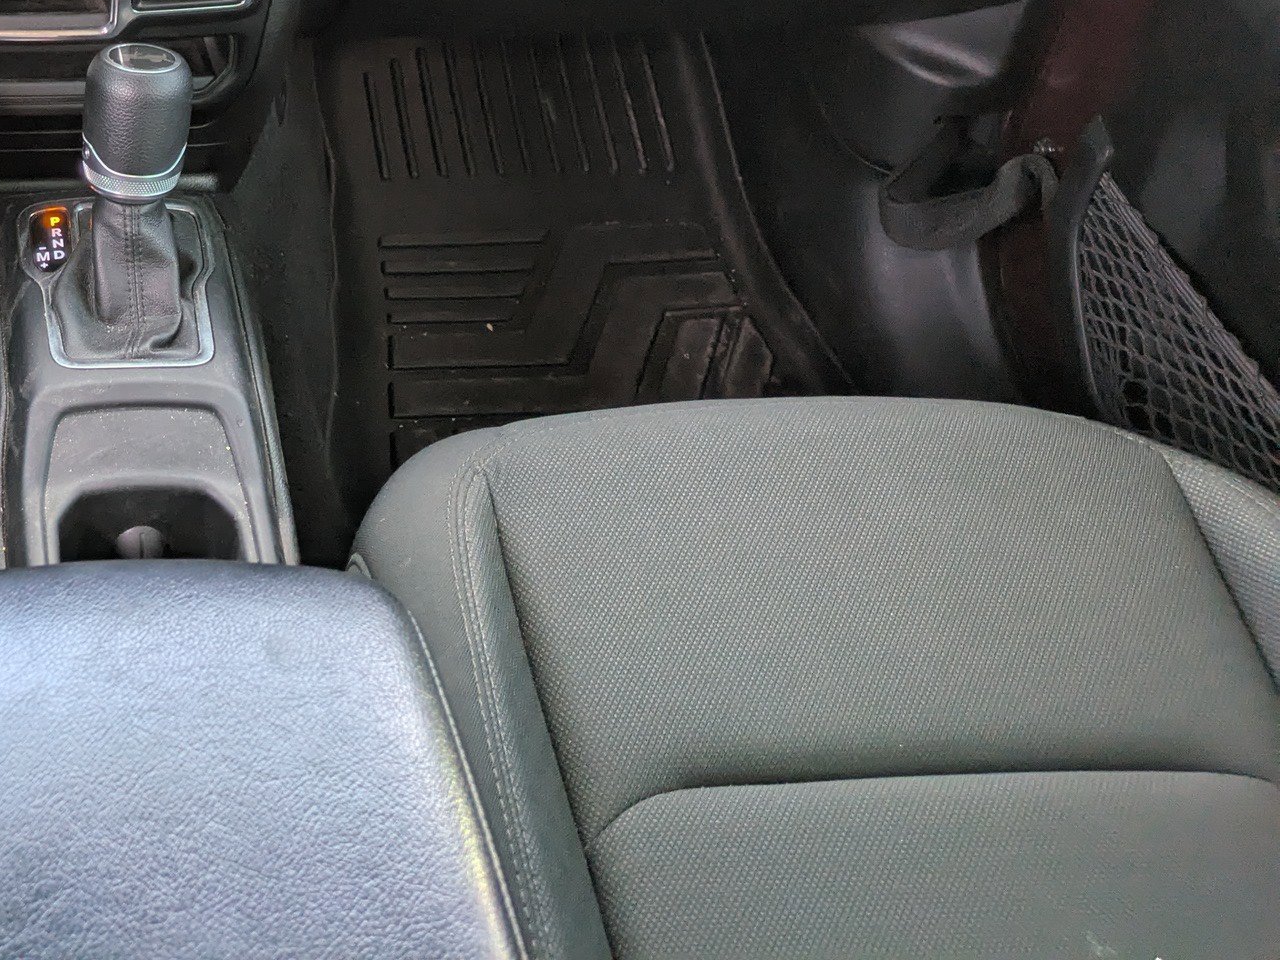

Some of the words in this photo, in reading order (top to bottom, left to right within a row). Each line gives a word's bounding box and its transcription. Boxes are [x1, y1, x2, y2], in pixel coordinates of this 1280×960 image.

[50, 216, 60, 227] P
[52, 227, 63, 237] R
[53, 238, 64, 249] N
[36, 251, 50, 262] M
[54, 250, 65, 260] D
